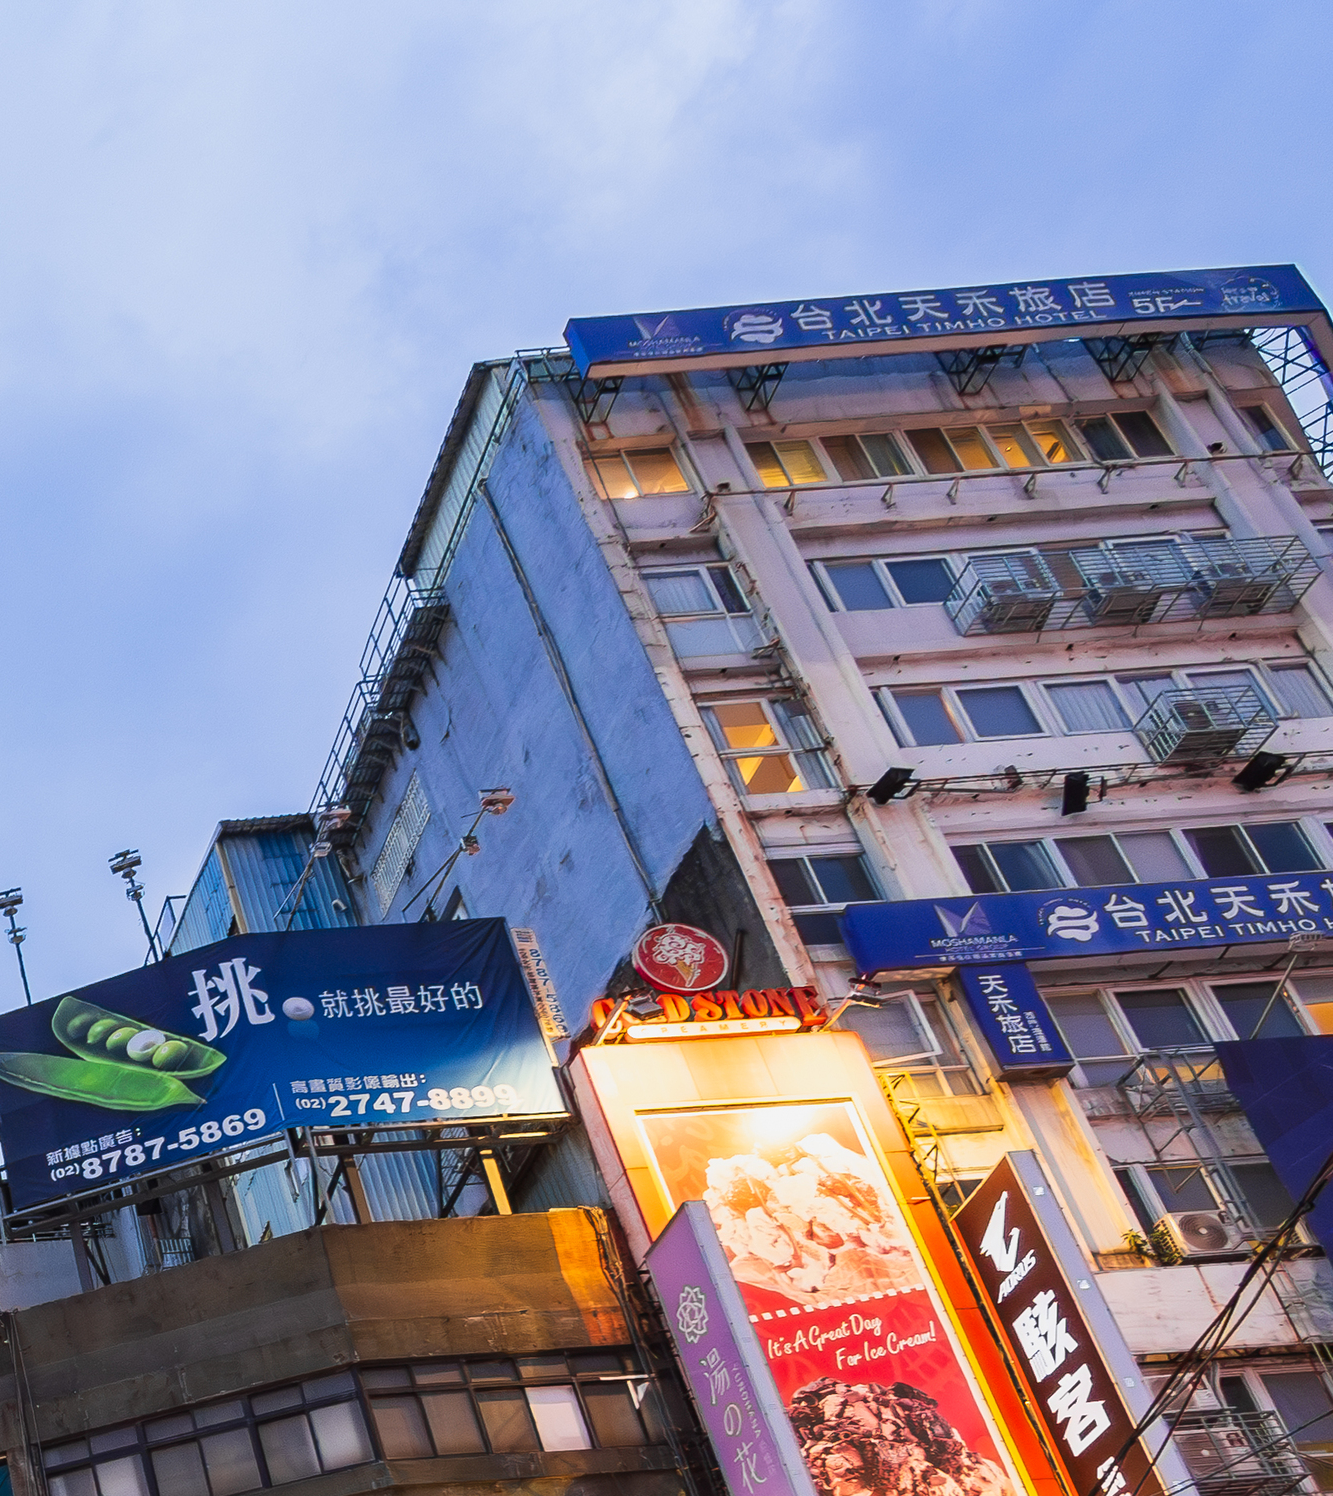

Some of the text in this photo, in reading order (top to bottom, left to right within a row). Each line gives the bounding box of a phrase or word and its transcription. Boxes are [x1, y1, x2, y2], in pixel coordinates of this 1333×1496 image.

[790, 281, 1116, 332] 台北天禾旅店
[822, 310, 1107, 340] TAIPEI TIMHO HOTEL
[1104, 879, 1333, 929] 台北天禾
[1136, 918, 1317, 944] TAIPEI TIMHO
[319, 982, 485, 1020] 就挑最好的
[691, 985, 829, 1027] STONE
[979, 974, 1037, 1054] 天禾旅店
[767, 1312, 883, 1360] It's A Great Day
[835, 1320, 937, 1371] For Ice Cream!
[1012, 1289, 1113, 1458] 駭客
[700, 1346, 767, 1494] 湯の花
